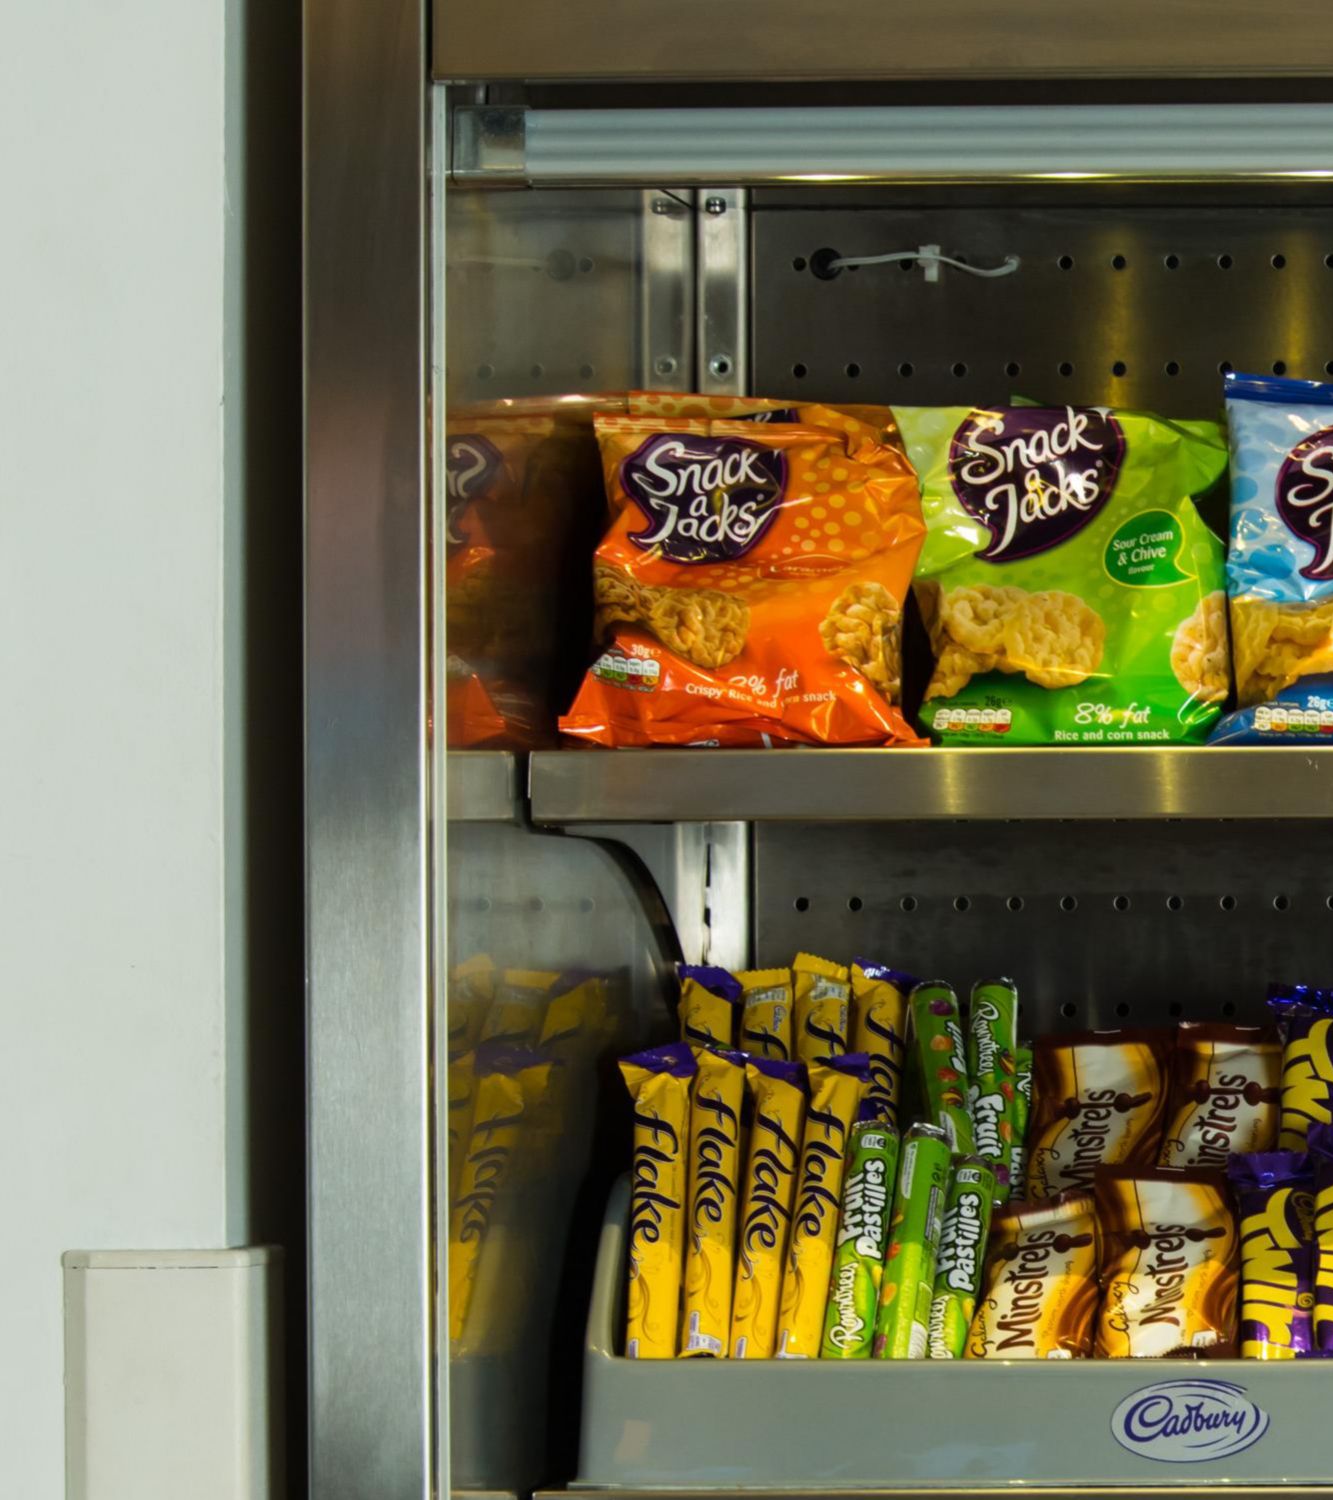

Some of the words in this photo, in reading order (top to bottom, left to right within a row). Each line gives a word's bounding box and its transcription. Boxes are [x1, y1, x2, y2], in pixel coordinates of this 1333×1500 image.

[634, 442, 767, 497] Snack
[961, 405, 1103, 484] Snack
[1112, 537, 1138, 553] Sour
[1138, 529, 1174, 546] Cream
[1132, 544, 1167, 564] Chive
[1054, 729, 1078, 741] Rice
[1082, 729, 1102, 741] and
[1133, 729, 1170, 741] snack
[1074, 701, 1114, 725] 8%
[1119, 702, 1151, 725] fat
[633, 1106, 681, 1245] Flake
[692, 1092, 739, 1225] Flake
[747, 1112, 799, 1250] Flake
[799, 1102, 844, 1238] Flake
[855, 1158, 887, 1260] Pastilles
[948, 1191, 980, 1292] Pastilles
[994, 1229, 1057, 1352] Minstrels
[1138, 1221, 1192, 1328] Minstrels
[1241, 1187, 1303, 1359] Twirl
[1123, 1394, 1247, 1443] Cadbury
